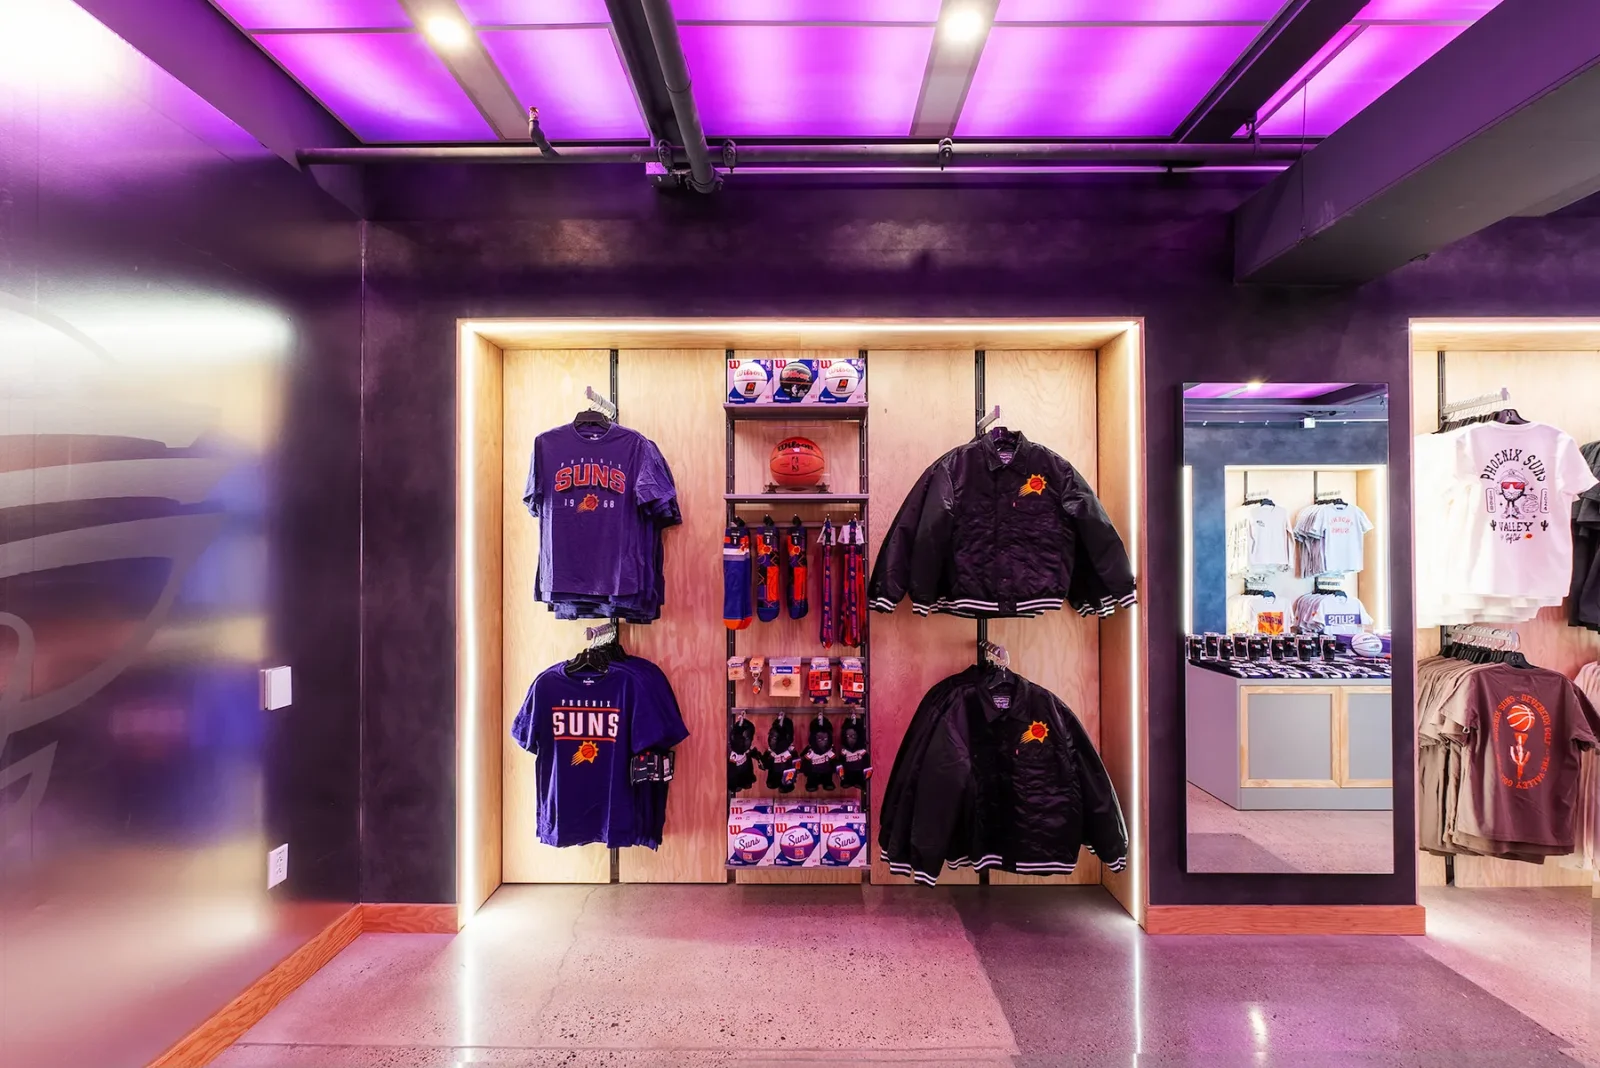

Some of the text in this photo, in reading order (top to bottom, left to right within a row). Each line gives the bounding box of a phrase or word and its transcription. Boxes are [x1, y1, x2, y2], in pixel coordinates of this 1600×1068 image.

[777, 441, 814, 452] Wilson
[1480, 448, 1546, 482] PHOENIX SUNS
[554, 463, 626, 494] SUNS
[1499, 521, 1534, 532] VALLEY
[552, 711, 620, 738] SUNS
[1516, 772, 1546, 790] VALLEY
[738, 836, 761, 850] Suns
[787, 832, 810, 847] Suns
[834, 835, 857, 848] Suns
